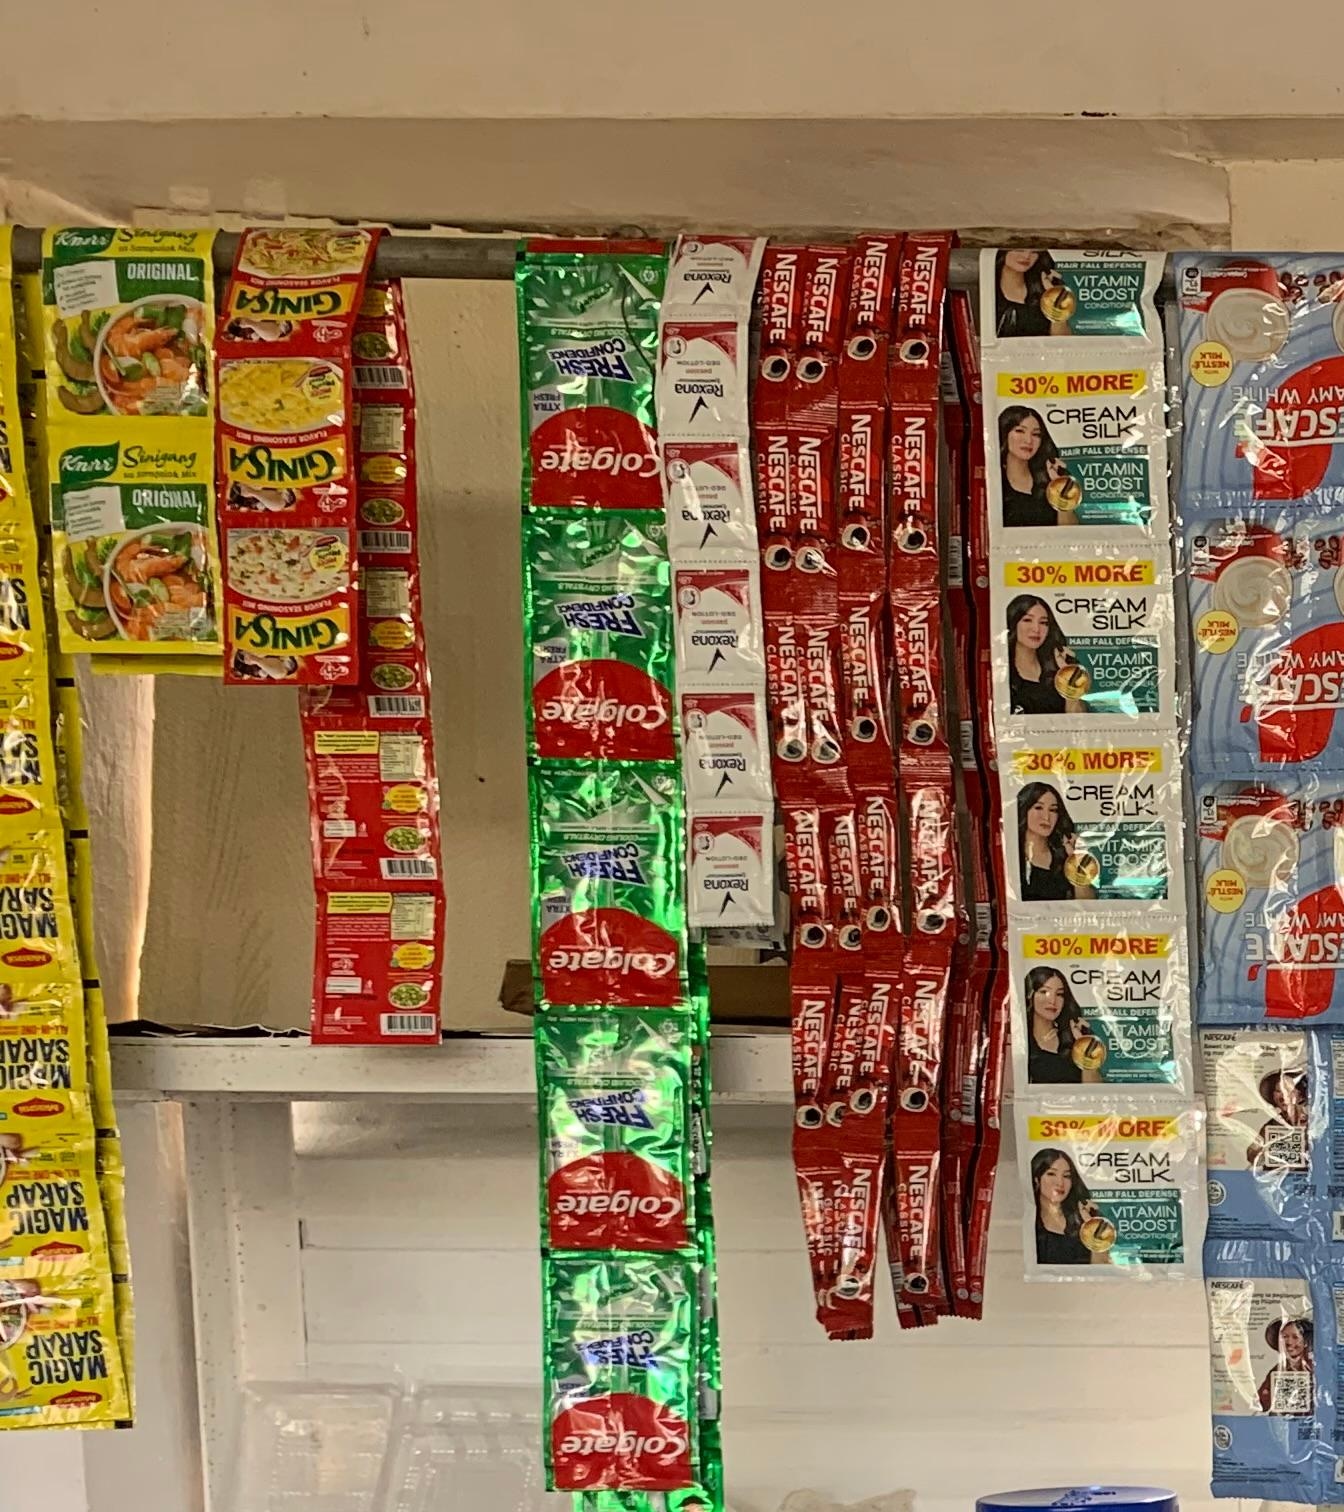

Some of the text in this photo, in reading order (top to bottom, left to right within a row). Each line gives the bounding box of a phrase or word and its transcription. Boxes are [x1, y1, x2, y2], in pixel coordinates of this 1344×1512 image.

[54, 229, 112, 248] Knorr
[127, 262, 197, 281] ORIGINAL
[549, 338, 626, 361] CONFIDENCE
[1200, 351, 1223, 360] MILK
[557, 354, 627, 381] FRESH
[1009, 375, 1060, 395] 30%
[1231, 385, 1302, 404] WHITE
[1046, 406, 1137, 425] CREAM
[1082, 423, 1136, 439] SILK
[121, 445, 197, 468] Sinigang
[1060, 448, 1080, 456] HAIR
[1082, 448, 1102, 456] FALL
[61, 452, 114, 473] Knorr
[540, 446, 661, 478] Colgate
[840, 432, 850, 494] CLASSIC
[891, 434, 902, 496] CLASSIC
[1076, 463, 1144, 476] VITAMIN
[1083, 476, 1144, 490] BOOST
[132, 488, 199, 509] ORIGINAL
[1016, 565, 1068, 584] 30%
[1055, 597, 1147, 614] CREAM
[1091, 614, 1146, 630] SILK
[691, 632, 740, 648] Rexona
[541, 698, 668, 731] Colgate
[703, 878, 750, 892] Rexona
[557, 1193, 682, 1222] Colgate
[1111, 1205, 1178, 1219] VITAMIN
[1117, 1218, 1177, 1232] BOOST
[23, 1329, 103, 1359] SARAP
[29, 1354, 109, 1386] MAGIC
[561, 1431, 687, 1460] Colgate
